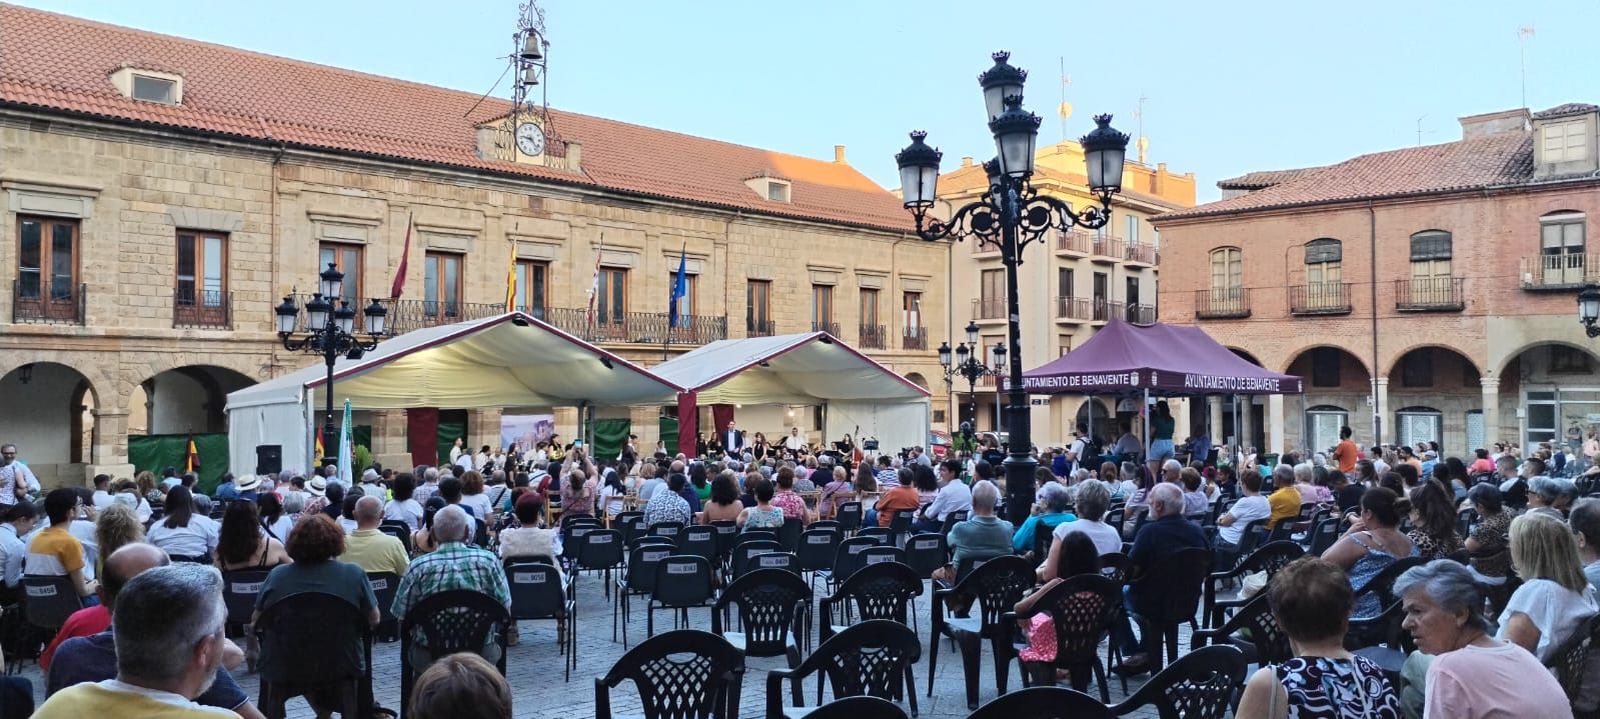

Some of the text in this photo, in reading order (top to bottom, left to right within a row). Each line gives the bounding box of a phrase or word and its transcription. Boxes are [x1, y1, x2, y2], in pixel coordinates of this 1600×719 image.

[1021, 374, 1129, 388] UNTAMIENTO DE BENAVENTE
[1184, 374, 1280, 391] AYUNTAMIENTO DE BENAVENTE
